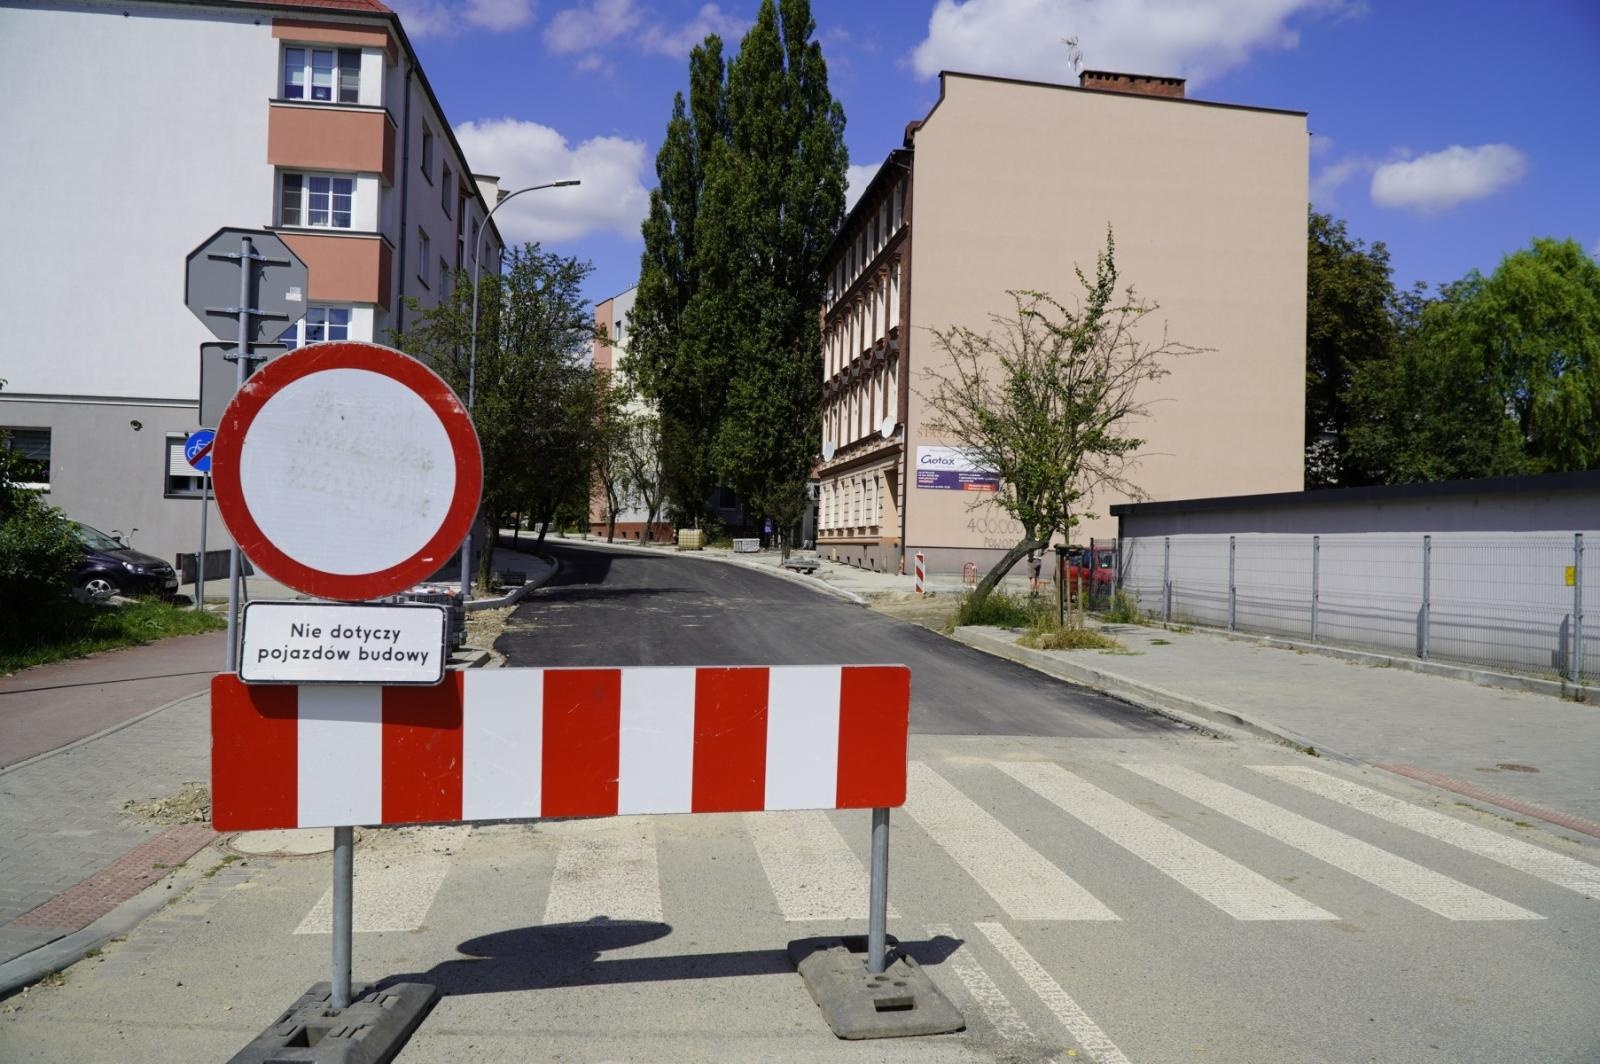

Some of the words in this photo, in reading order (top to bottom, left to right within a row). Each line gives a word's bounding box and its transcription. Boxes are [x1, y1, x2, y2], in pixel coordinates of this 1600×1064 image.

[920, 454, 955, 465] Gotax
[291, 623, 322, 639] Nie
[330, 624, 401, 643] dotyczy
[258, 645, 350, 663] pojazdów
[359, 647, 428, 665] budowy
